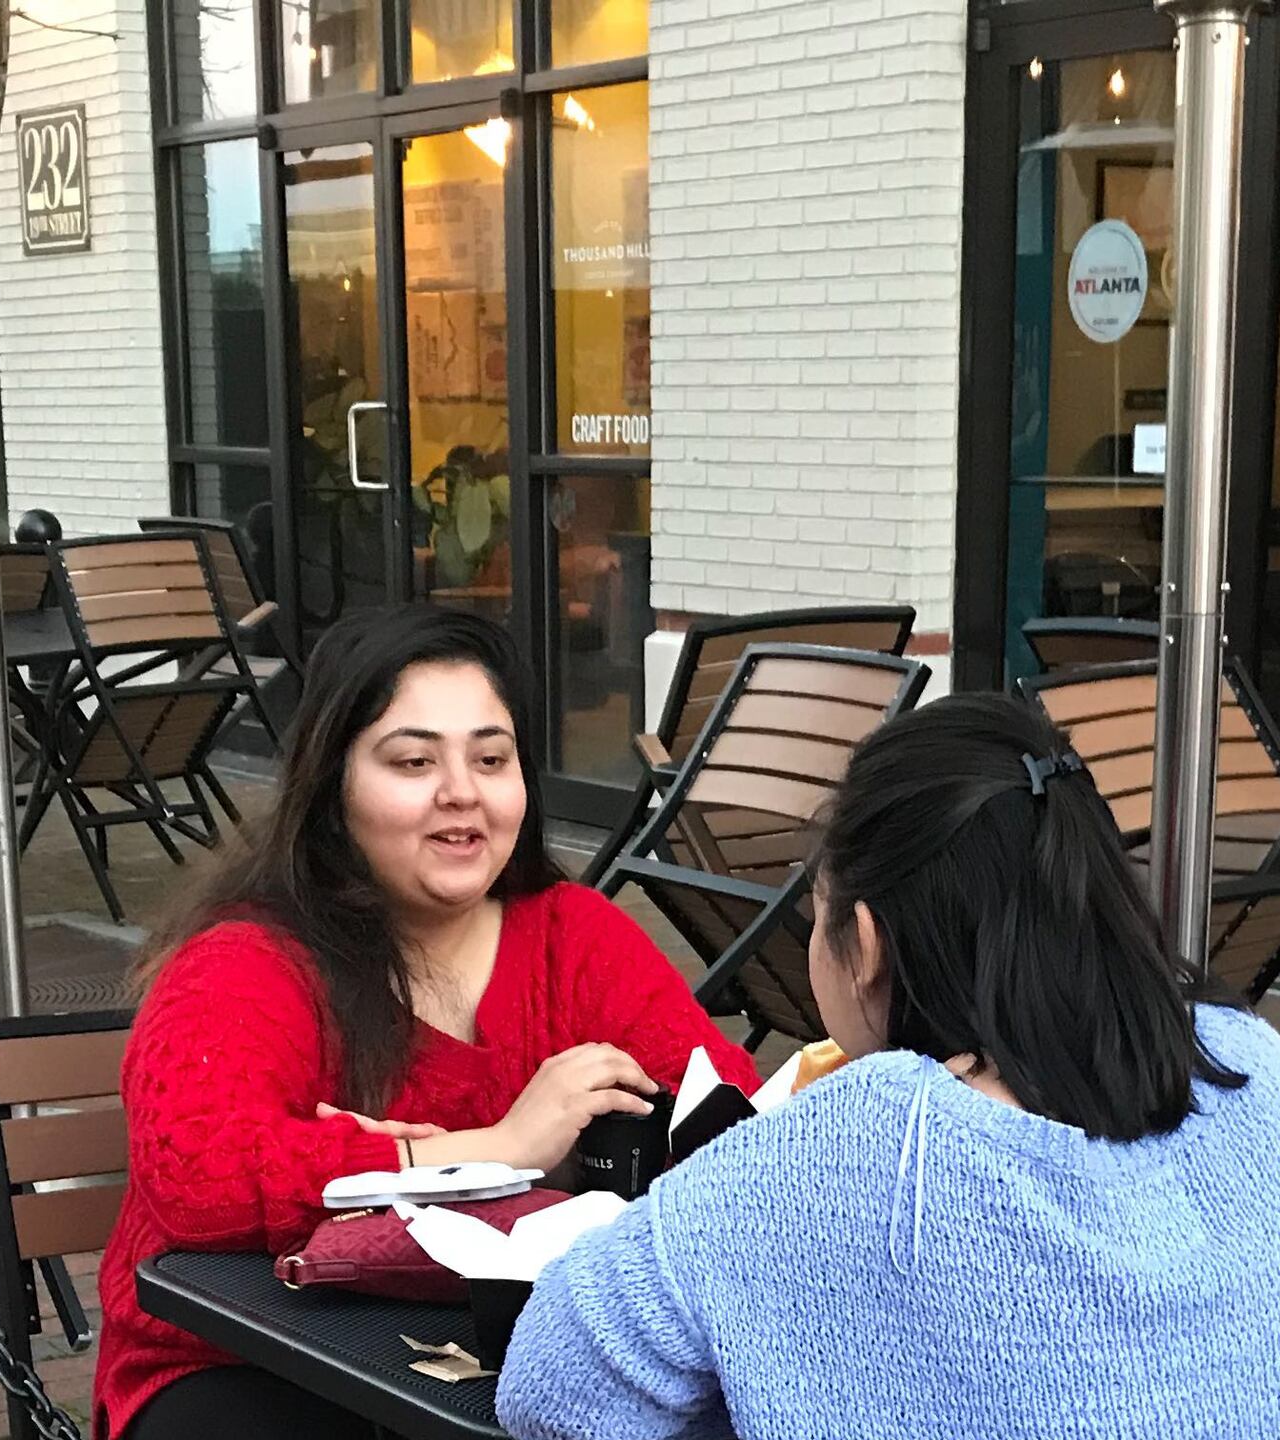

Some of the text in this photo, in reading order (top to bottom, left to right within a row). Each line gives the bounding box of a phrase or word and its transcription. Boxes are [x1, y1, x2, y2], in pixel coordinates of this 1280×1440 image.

[24, 121, 81, 211] 232
[563, 242, 650, 263] THOUSAND HILL
[1075, 277, 1141, 294] ATLANTA
[572, 414, 649, 444] CRAFT FOOD
[584, 1155, 614, 1170] HILLS
